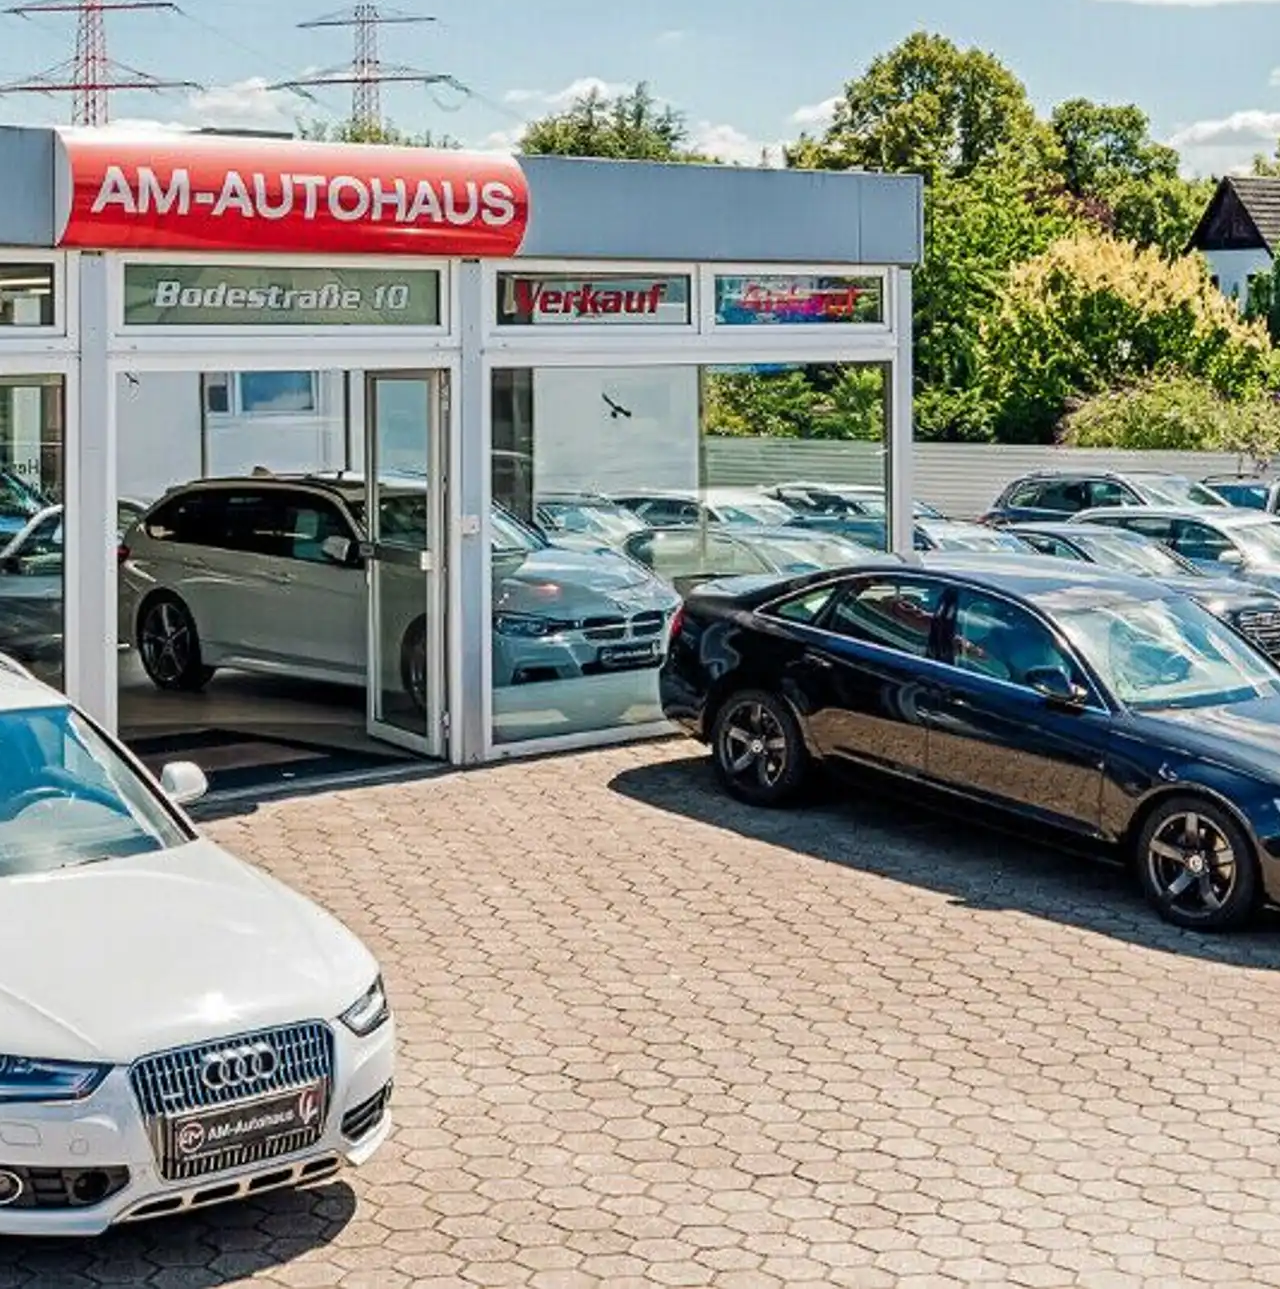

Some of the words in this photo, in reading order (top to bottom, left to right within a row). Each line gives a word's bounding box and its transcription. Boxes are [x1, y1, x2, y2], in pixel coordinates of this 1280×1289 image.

[90, 165, 515, 226] AM-AUTOHAUS
[154, 280, 360, 310] Bodestraße
[371, 284, 409, 310] 10
[516, 280, 667, 315] Verkauf
